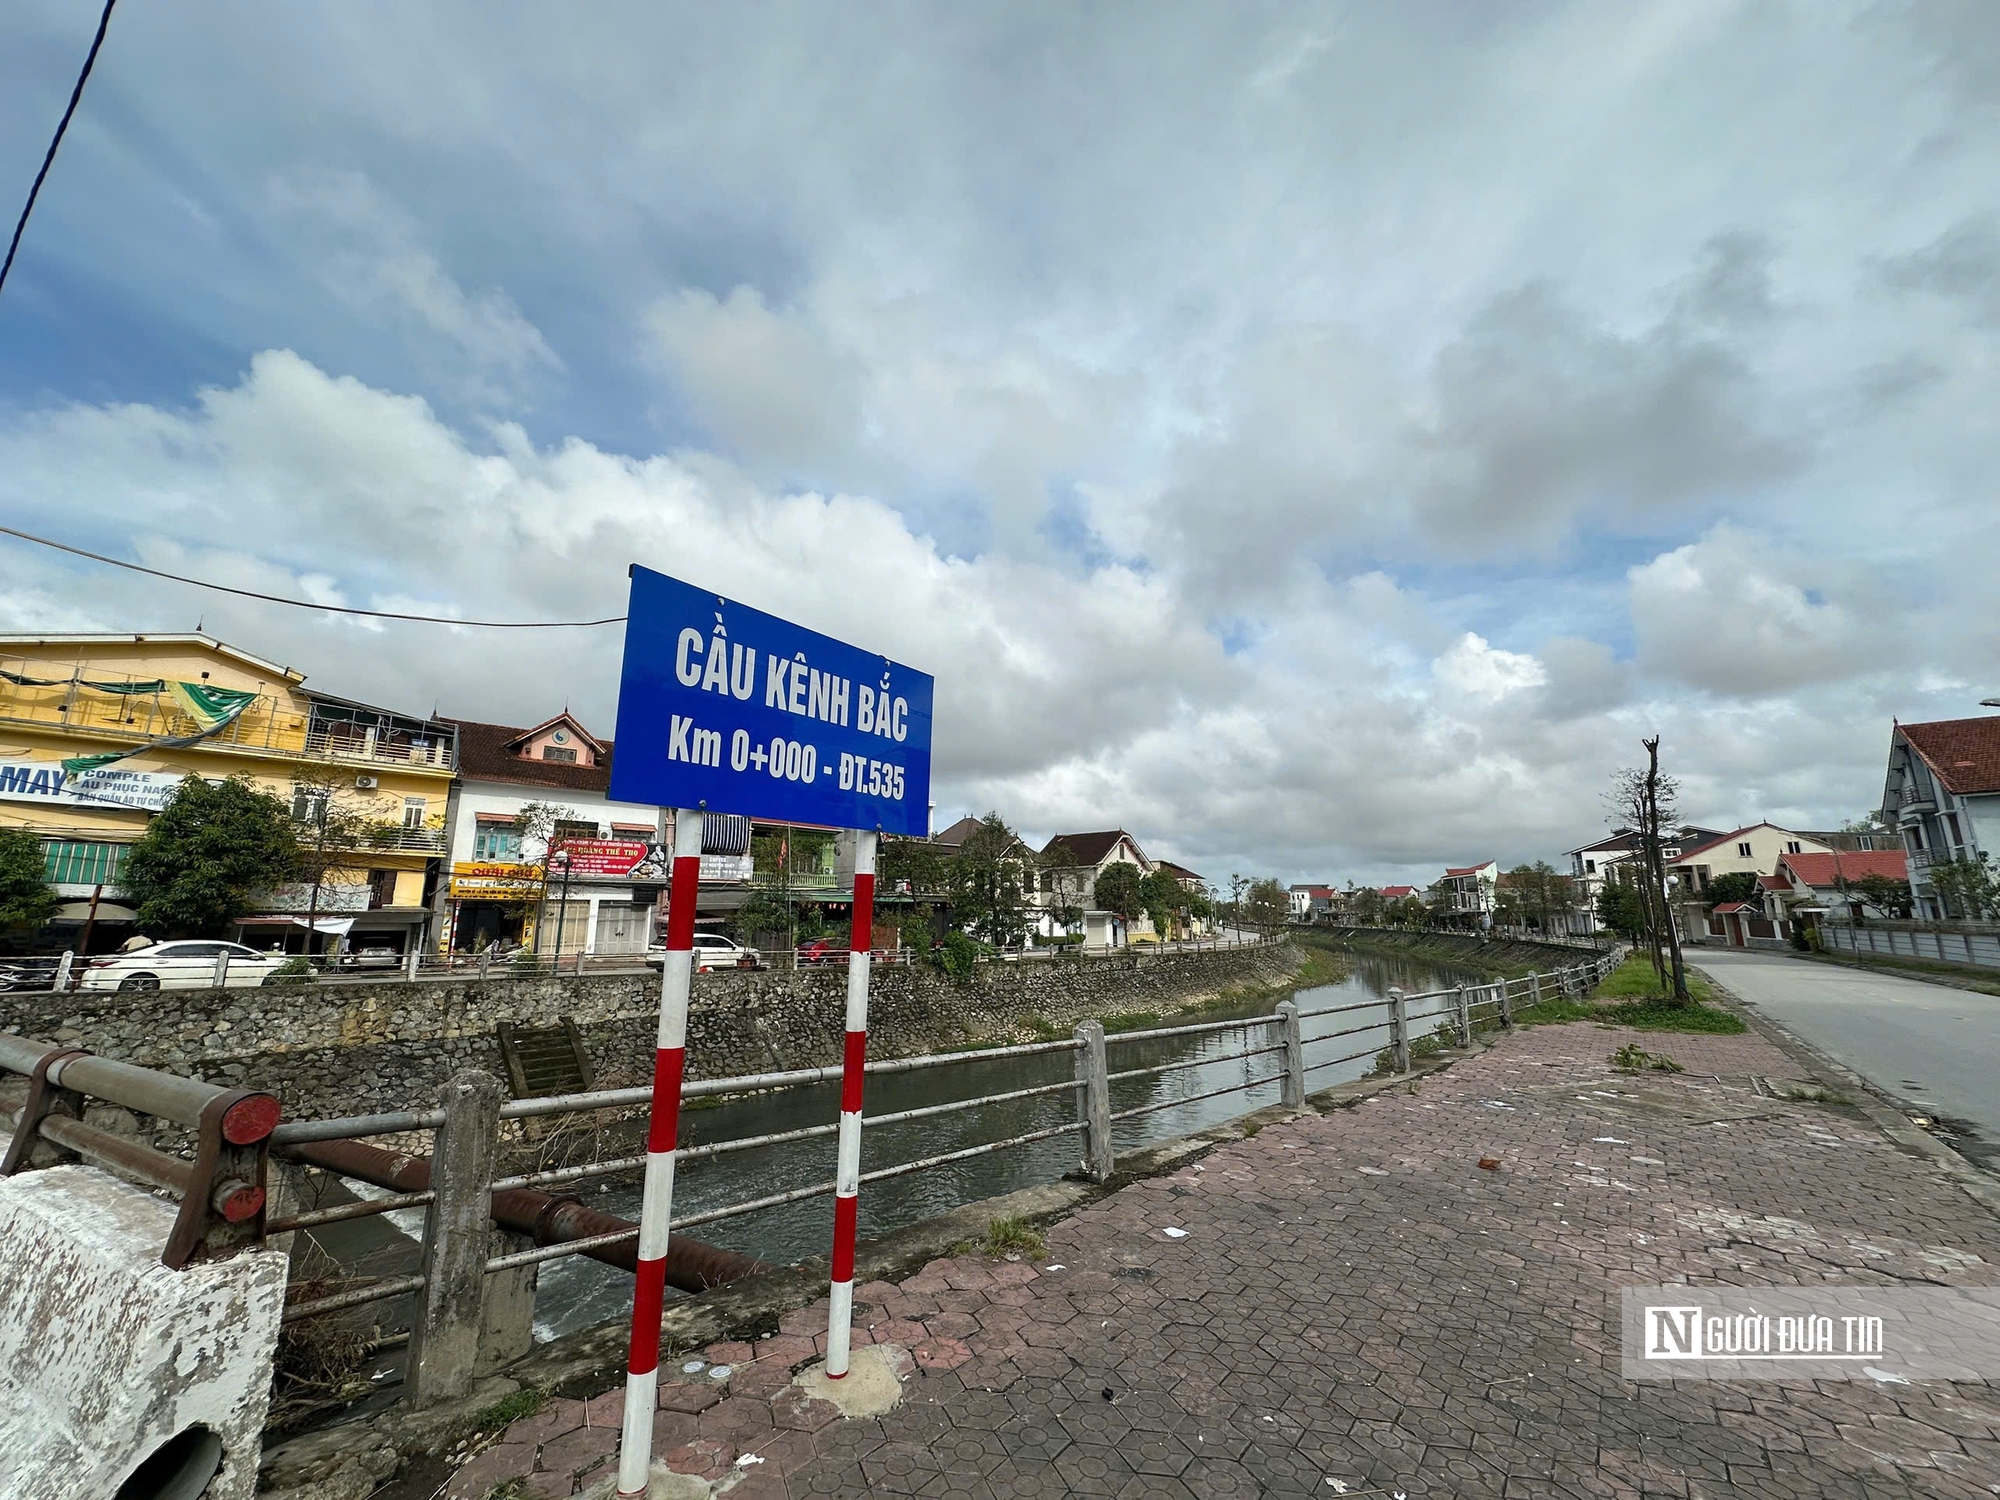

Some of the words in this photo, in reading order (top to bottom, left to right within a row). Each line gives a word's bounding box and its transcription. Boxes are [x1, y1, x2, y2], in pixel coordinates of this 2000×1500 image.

[675, 612, 756, 701] CẦU
[765, 652, 850, 727] KÊNH
[857, 672, 909, 742] BẮC
[0, 766, 68, 795] MAY
[84, 770, 151, 783] COMPLE
[667, 714, 722, 768] Km
[731, 729, 817, 784] 0+000
[823, 765, 832, 775] -
[839, 752, 905, 800] ĐT.535
